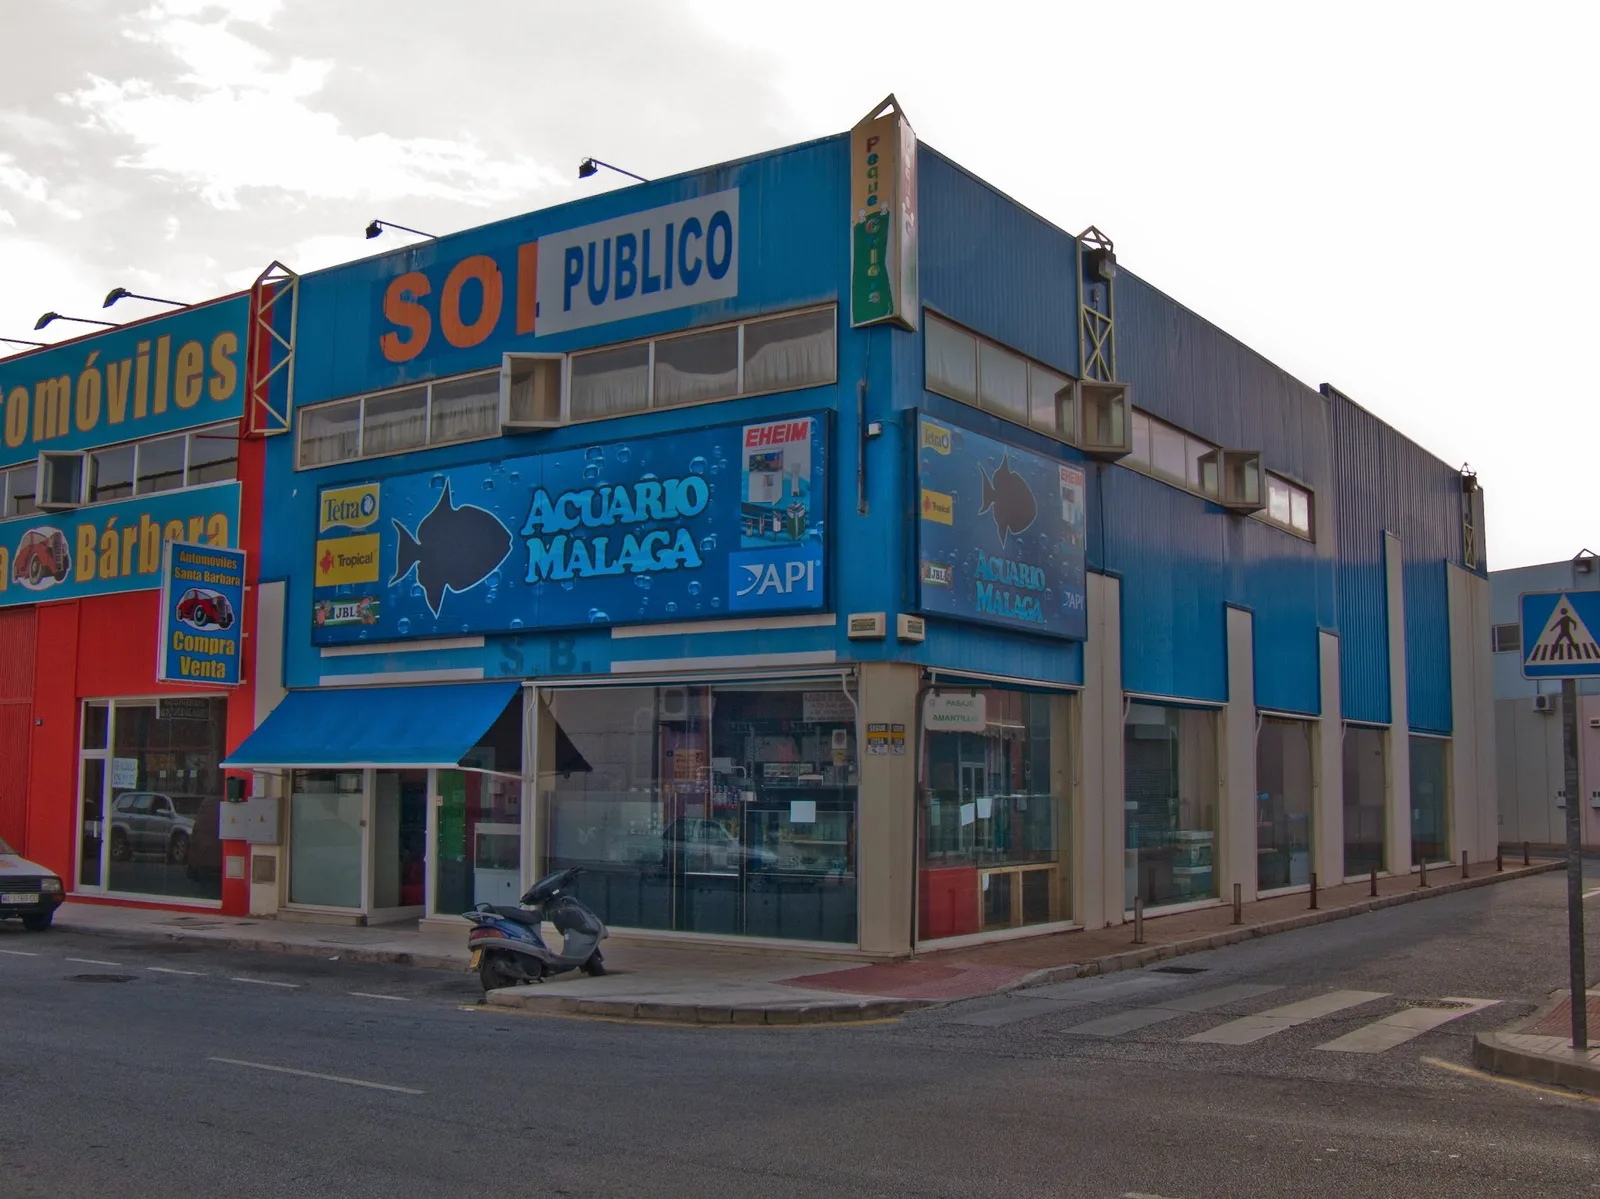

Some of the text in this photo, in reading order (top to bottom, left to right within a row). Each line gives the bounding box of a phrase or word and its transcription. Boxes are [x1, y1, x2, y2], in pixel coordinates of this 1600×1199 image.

[563, 210, 733, 313] PUBLICO
[0, 331, 238, 448] omóviles
[744, 420, 809, 448] EHEIM
[324, 498, 360, 522] Tetra
[521, 475, 709, 536] ACUARIO
[931, 501, 950, 515] Tropical
[337, 551, 373, 568] Tropical
[525, 528, 703, 583] MALAGA
[174, 566, 202, 581] Santa
[756, 560, 814, 595] API
[932, 568, 945, 581] JBL
[974, 549, 1046, 591] ACUARIO
[336, 607, 356, 619] JBL
[976, 581, 1044, 623] MALAGA
[172, 630, 235, 656] Compra
[180, 655, 226, 679] Venta
[946, 699, 974, 707] PASAJE
